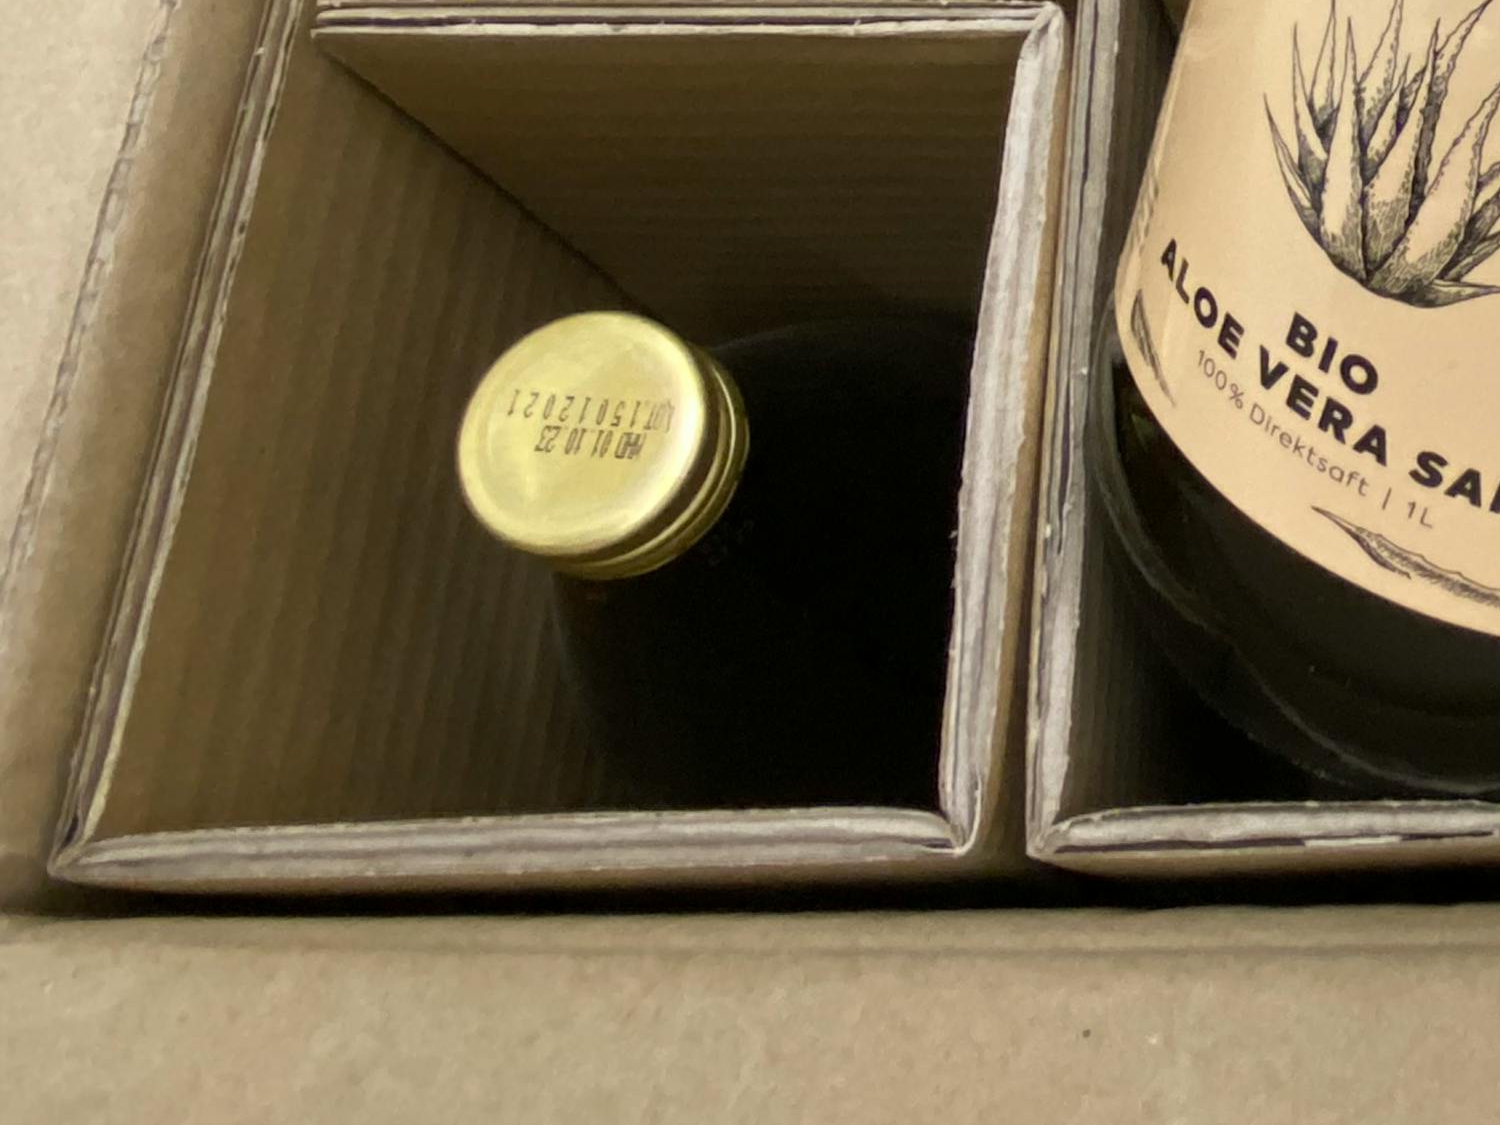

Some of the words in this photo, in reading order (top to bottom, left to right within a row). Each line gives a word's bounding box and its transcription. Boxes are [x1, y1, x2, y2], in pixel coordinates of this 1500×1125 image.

[1160, 237, 1246, 360] ALOE
[1258, 343, 1388, 468] VERA
[1196, 348, 1244, 412] 100%
[1248, 401, 1371, 499] Direktsaft
[1406, 501, 1435, 530] 1L
[1285, 310, 1380, 397] BIO
